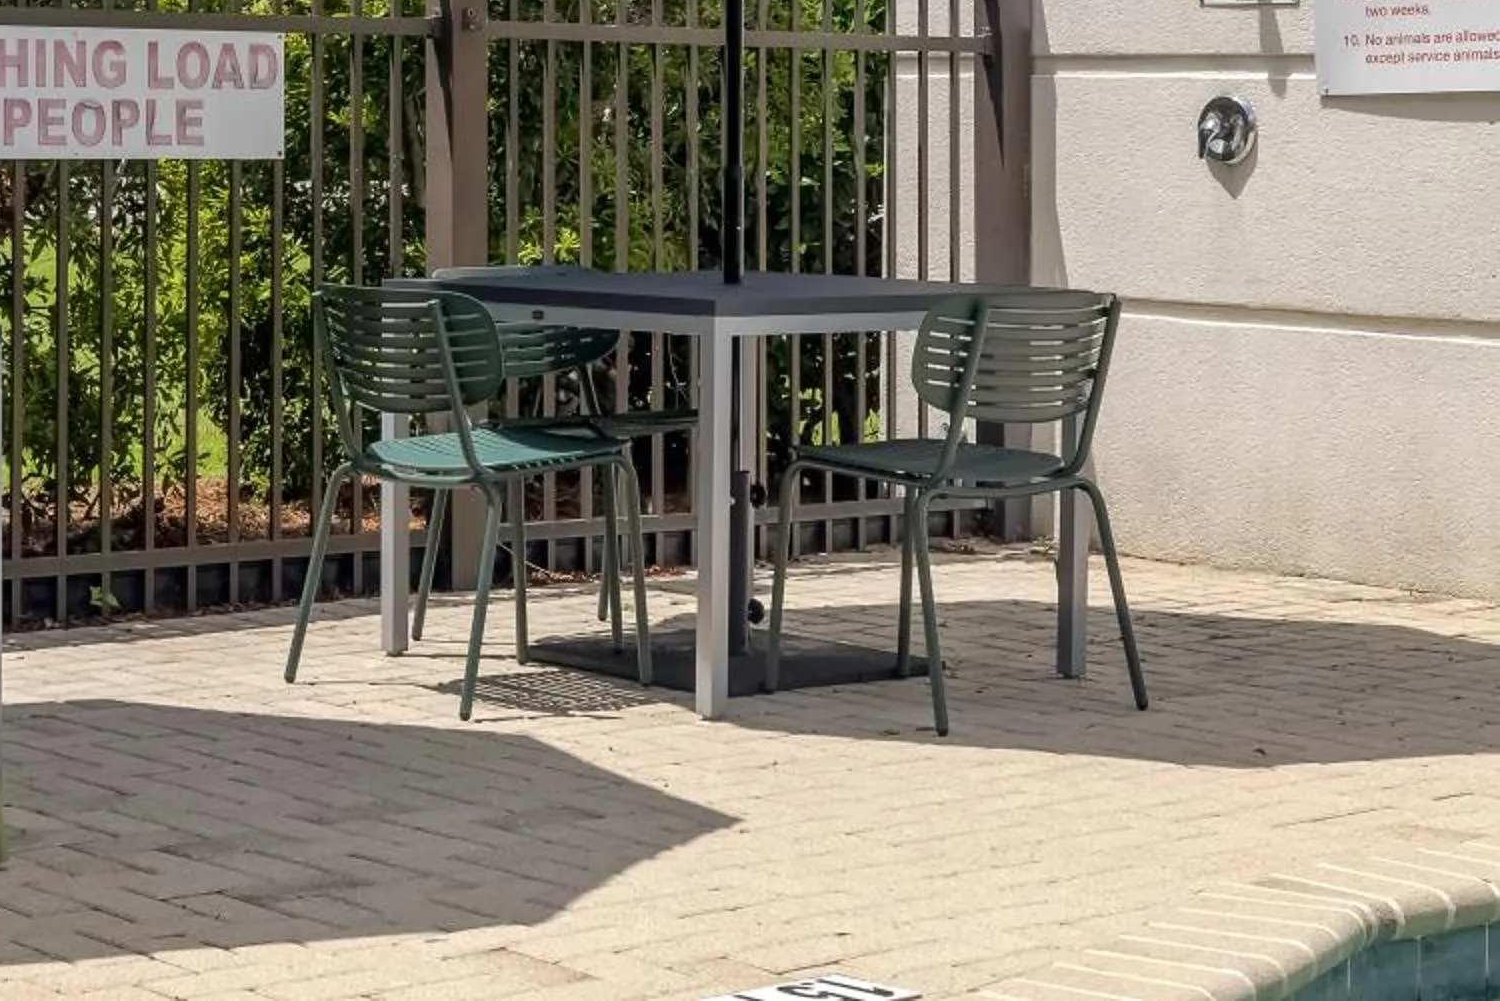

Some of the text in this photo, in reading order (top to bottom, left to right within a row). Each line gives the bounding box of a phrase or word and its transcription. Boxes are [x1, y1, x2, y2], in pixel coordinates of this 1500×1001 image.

[1365, 5, 1387, 18] two
[1365, 34, 1382, 47] No
[1385, 31, 1431, 46] animals
[1433, 33, 1453, 45] are
[147, 40, 278, 90] LOAD
[1365, 52, 1405, 66] except
[1407, 50, 1451, 64] service
[3, 98, 206, 147] PEOPLE
